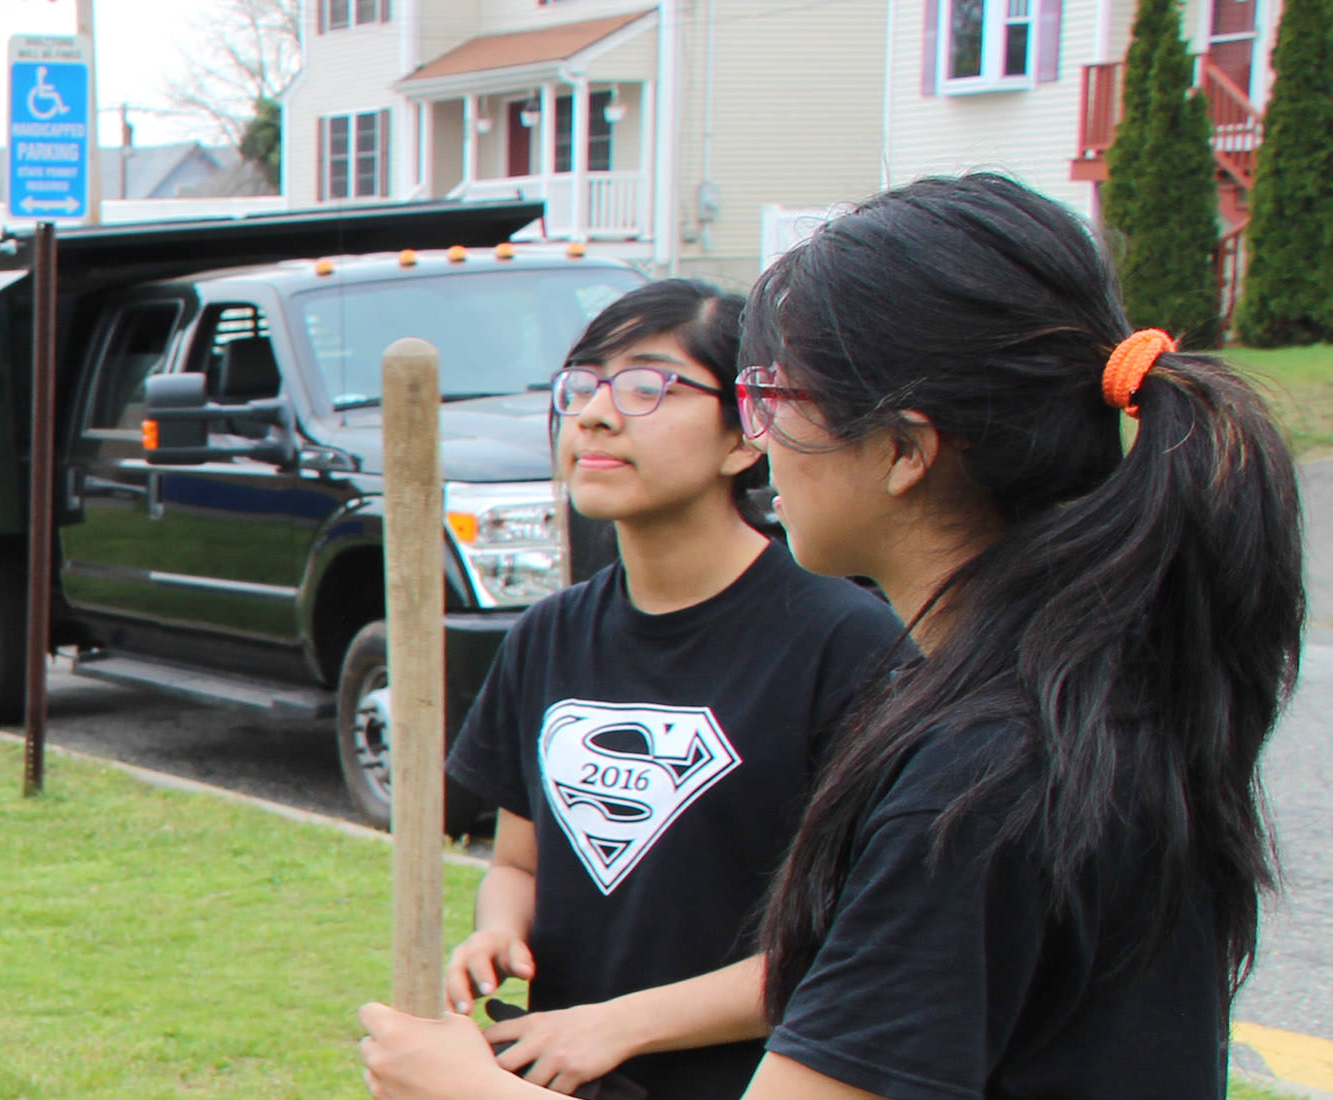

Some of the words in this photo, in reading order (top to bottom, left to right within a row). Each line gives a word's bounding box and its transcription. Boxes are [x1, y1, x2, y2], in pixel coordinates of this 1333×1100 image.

[11, 122, 87, 138] HANDICAPPED
[17, 141, 80, 162] PARKING
[579, 762, 652, 792] 2016
